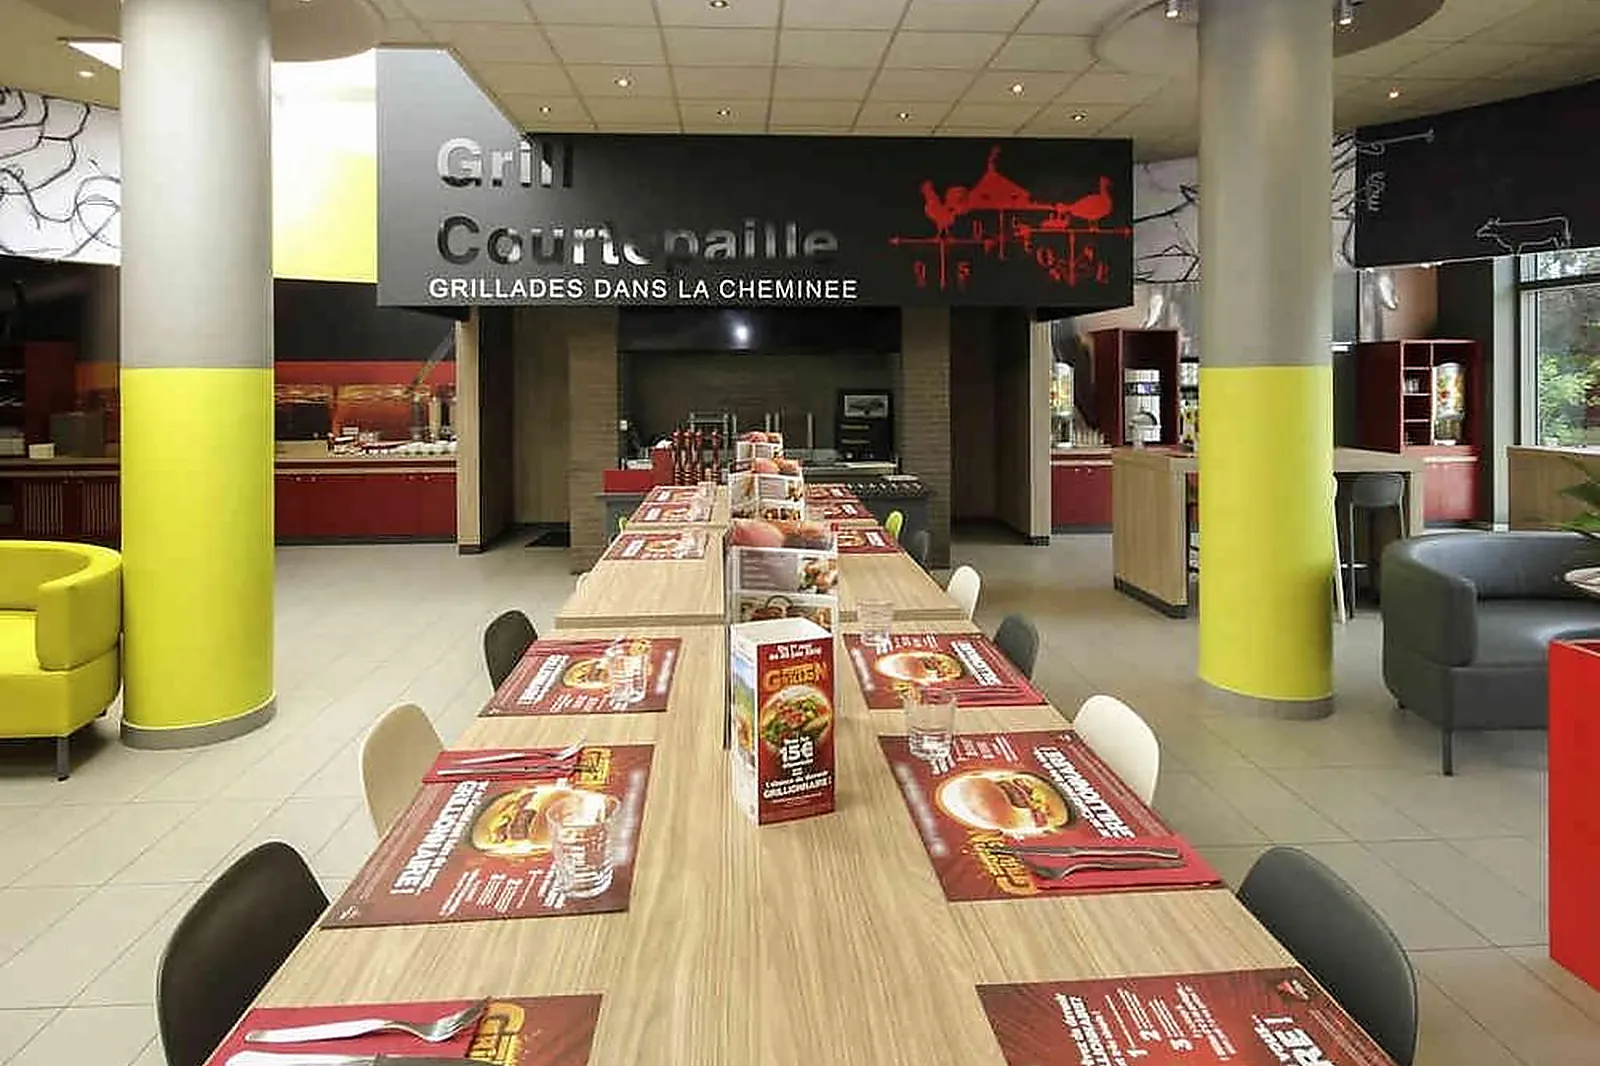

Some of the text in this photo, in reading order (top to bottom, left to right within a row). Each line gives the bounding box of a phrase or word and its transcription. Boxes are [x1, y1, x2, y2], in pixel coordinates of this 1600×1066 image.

[437, 136, 574, 188] Grill
[429, 278, 858, 299] GRILLADES DANS LA CHEMINEE
[780, 740, 814, 762] 15€
